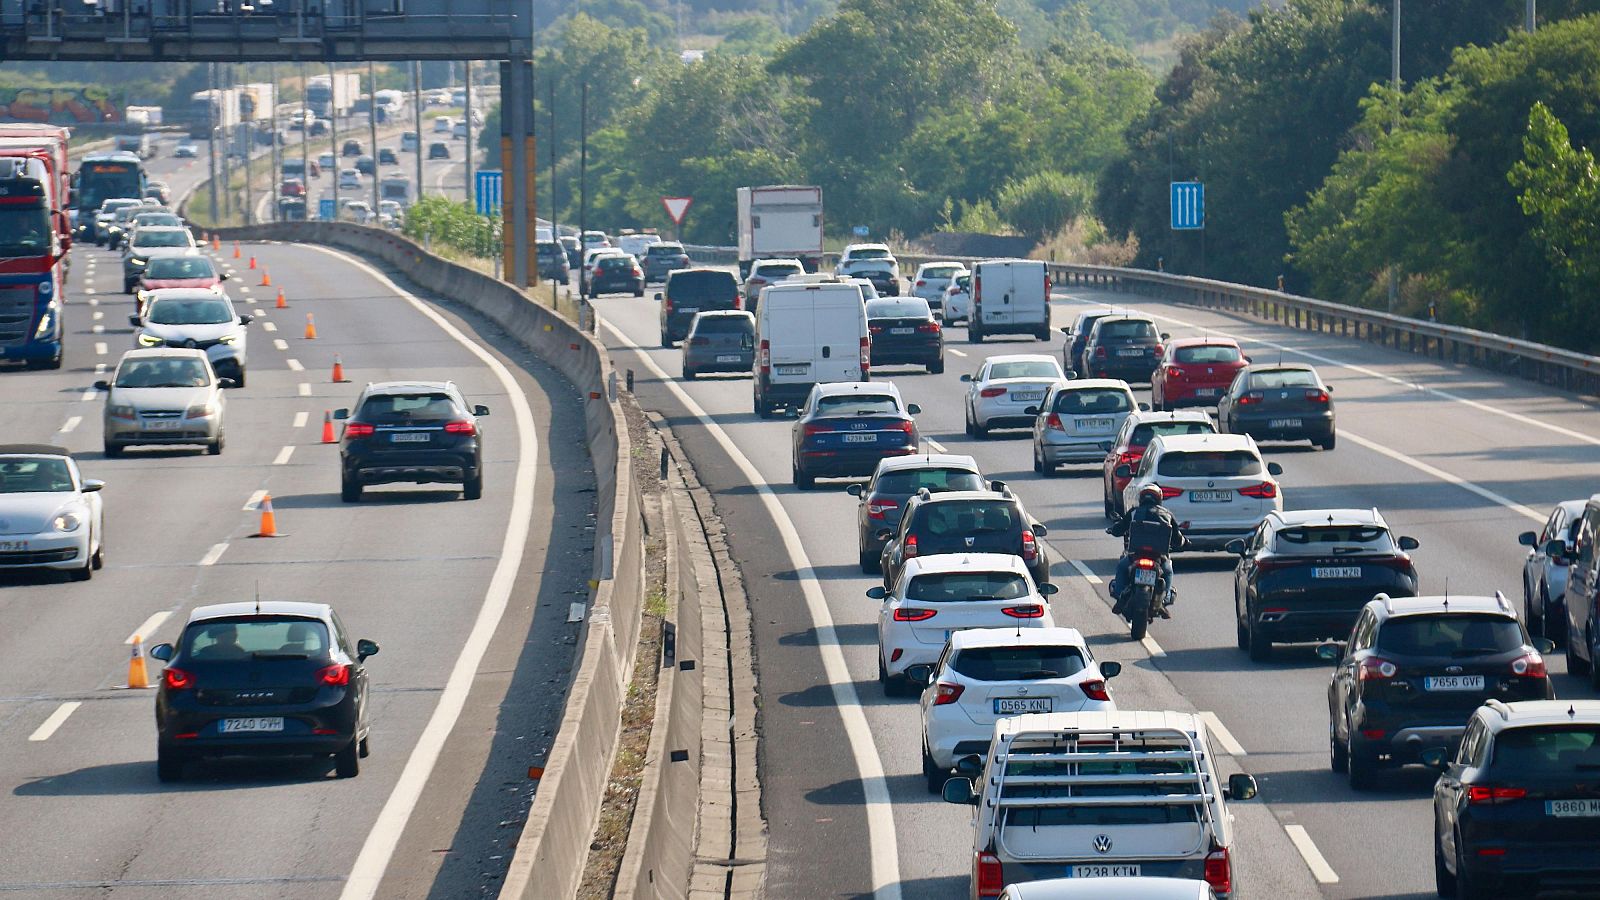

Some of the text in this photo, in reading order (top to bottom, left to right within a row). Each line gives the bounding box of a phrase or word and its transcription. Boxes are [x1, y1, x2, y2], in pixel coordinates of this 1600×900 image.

[1433, 676, 1481, 687] 7656 GVF
[1001, 700, 1049, 710] 0565 KNL
[226, 719, 255, 730] 7240
[1554, 801, 1586, 812] 3860
[1077, 866, 1138, 877] 1238 KTM
